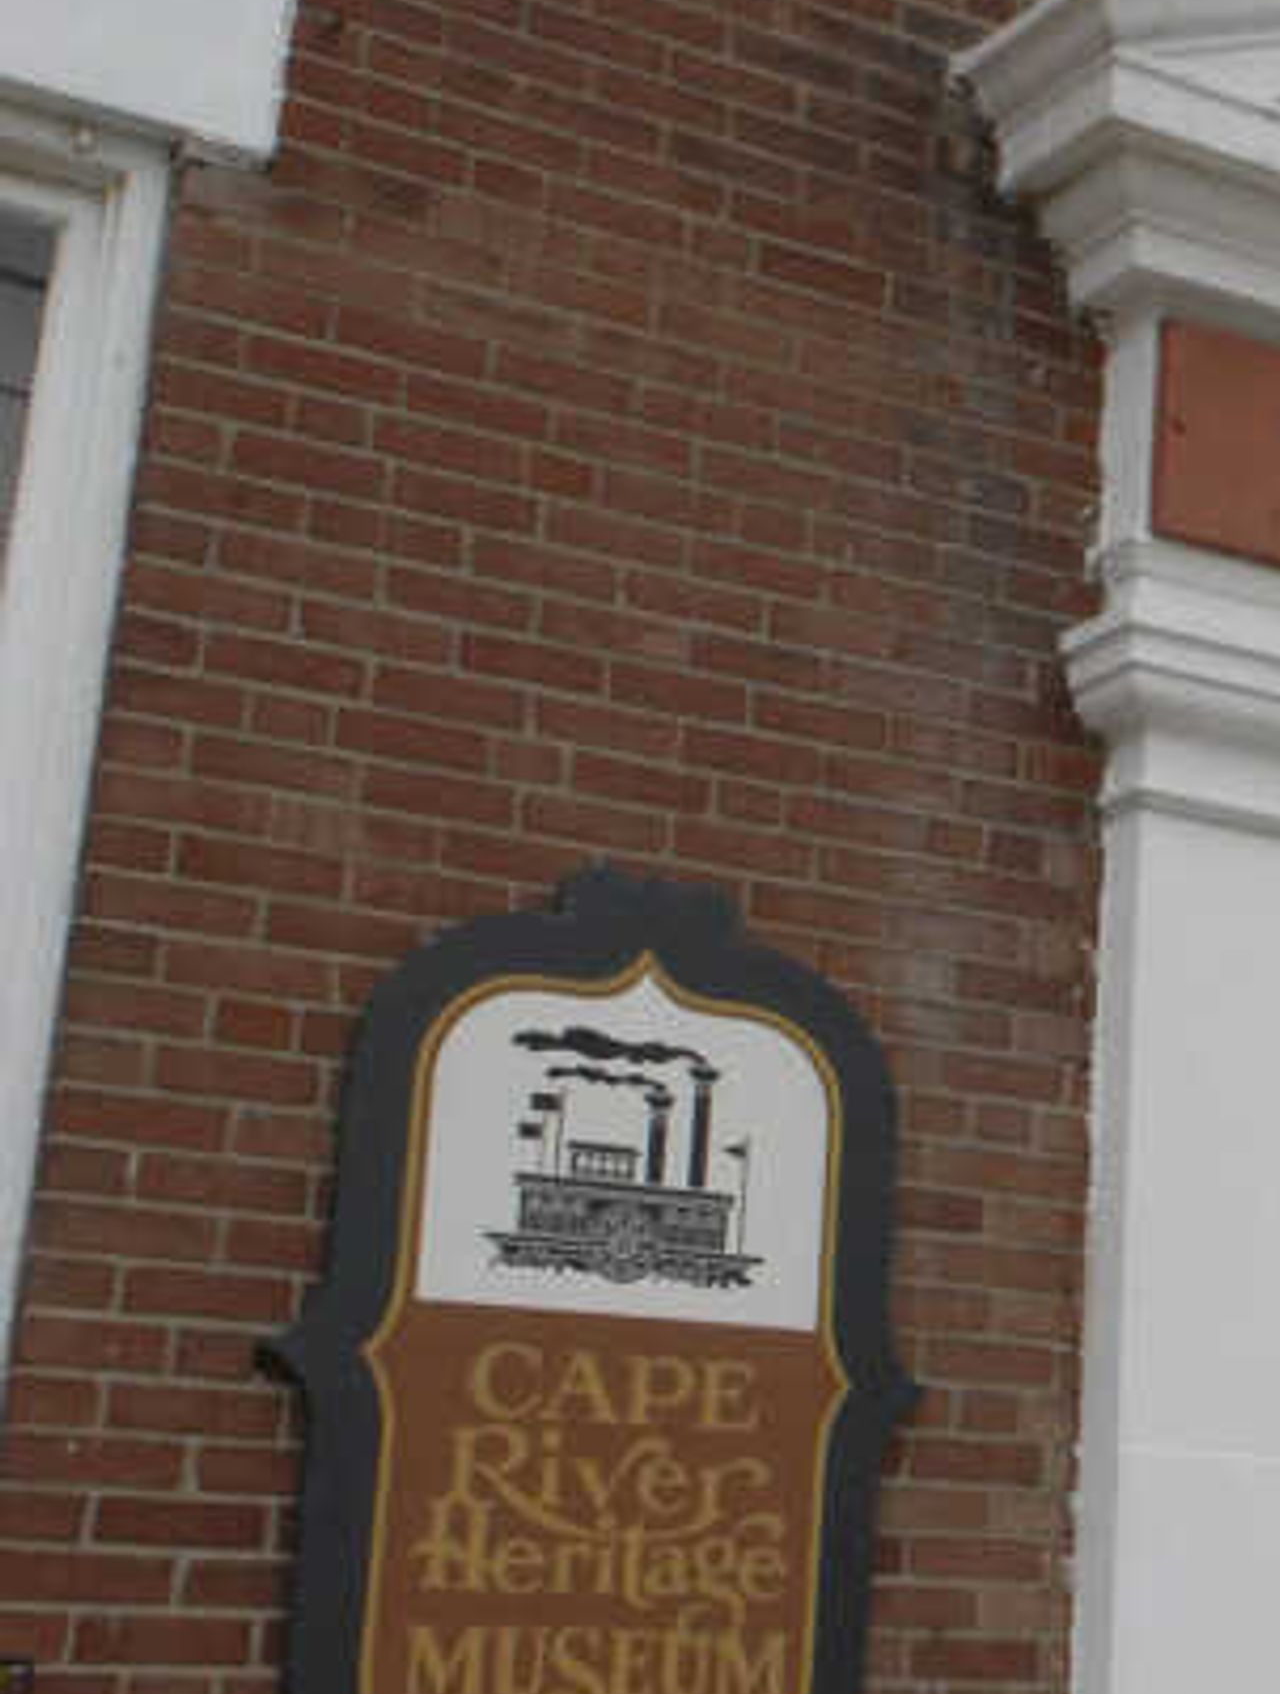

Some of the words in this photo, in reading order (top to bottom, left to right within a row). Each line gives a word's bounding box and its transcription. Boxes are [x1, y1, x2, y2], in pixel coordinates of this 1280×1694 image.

[472, 1343, 758, 1431] CAPE
[448, 1424, 772, 1541] River
[411, 1495, 787, 1634] Heritage
